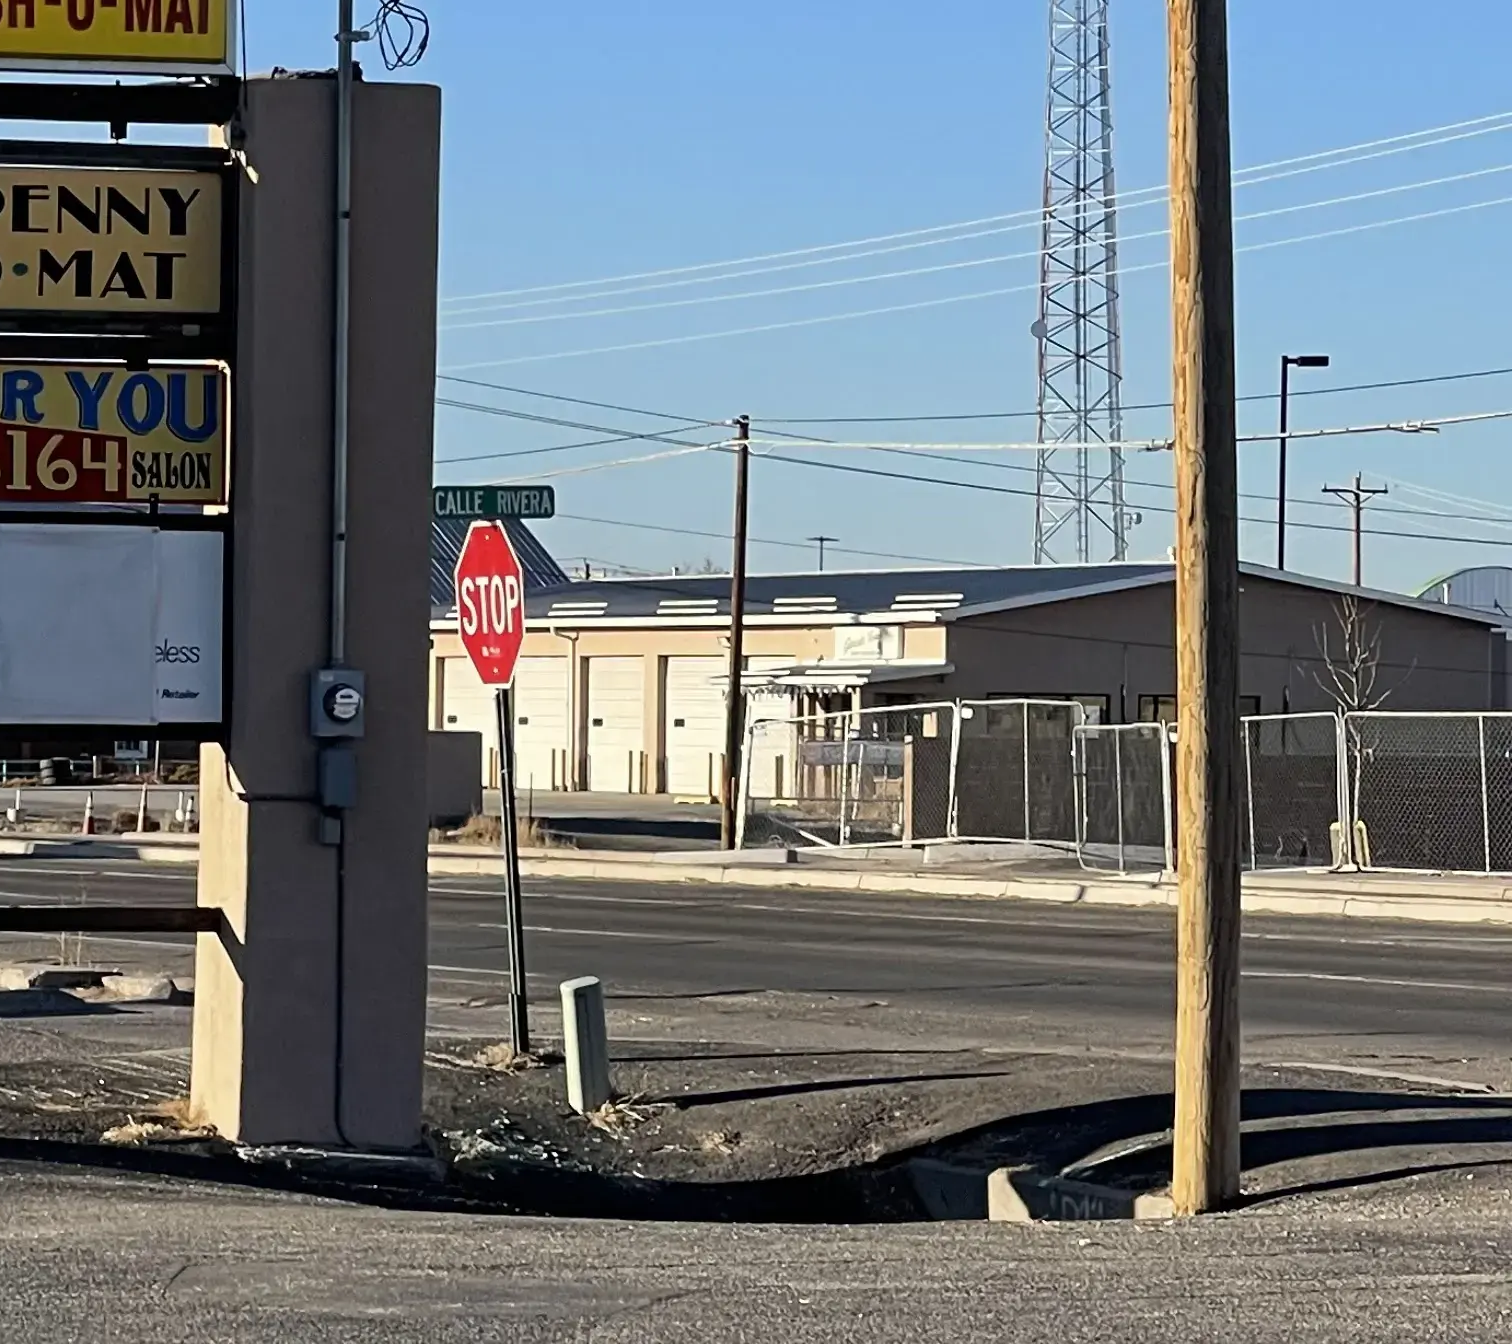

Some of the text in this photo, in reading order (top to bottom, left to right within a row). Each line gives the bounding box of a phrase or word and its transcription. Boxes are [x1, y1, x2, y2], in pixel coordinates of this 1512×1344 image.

[63, 370, 220, 443] YOU
[130, 451, 212, 490] SALON
[435, 490, 553, 515] CALLE RIVERA
[460, 574, 520, 636] STOP
